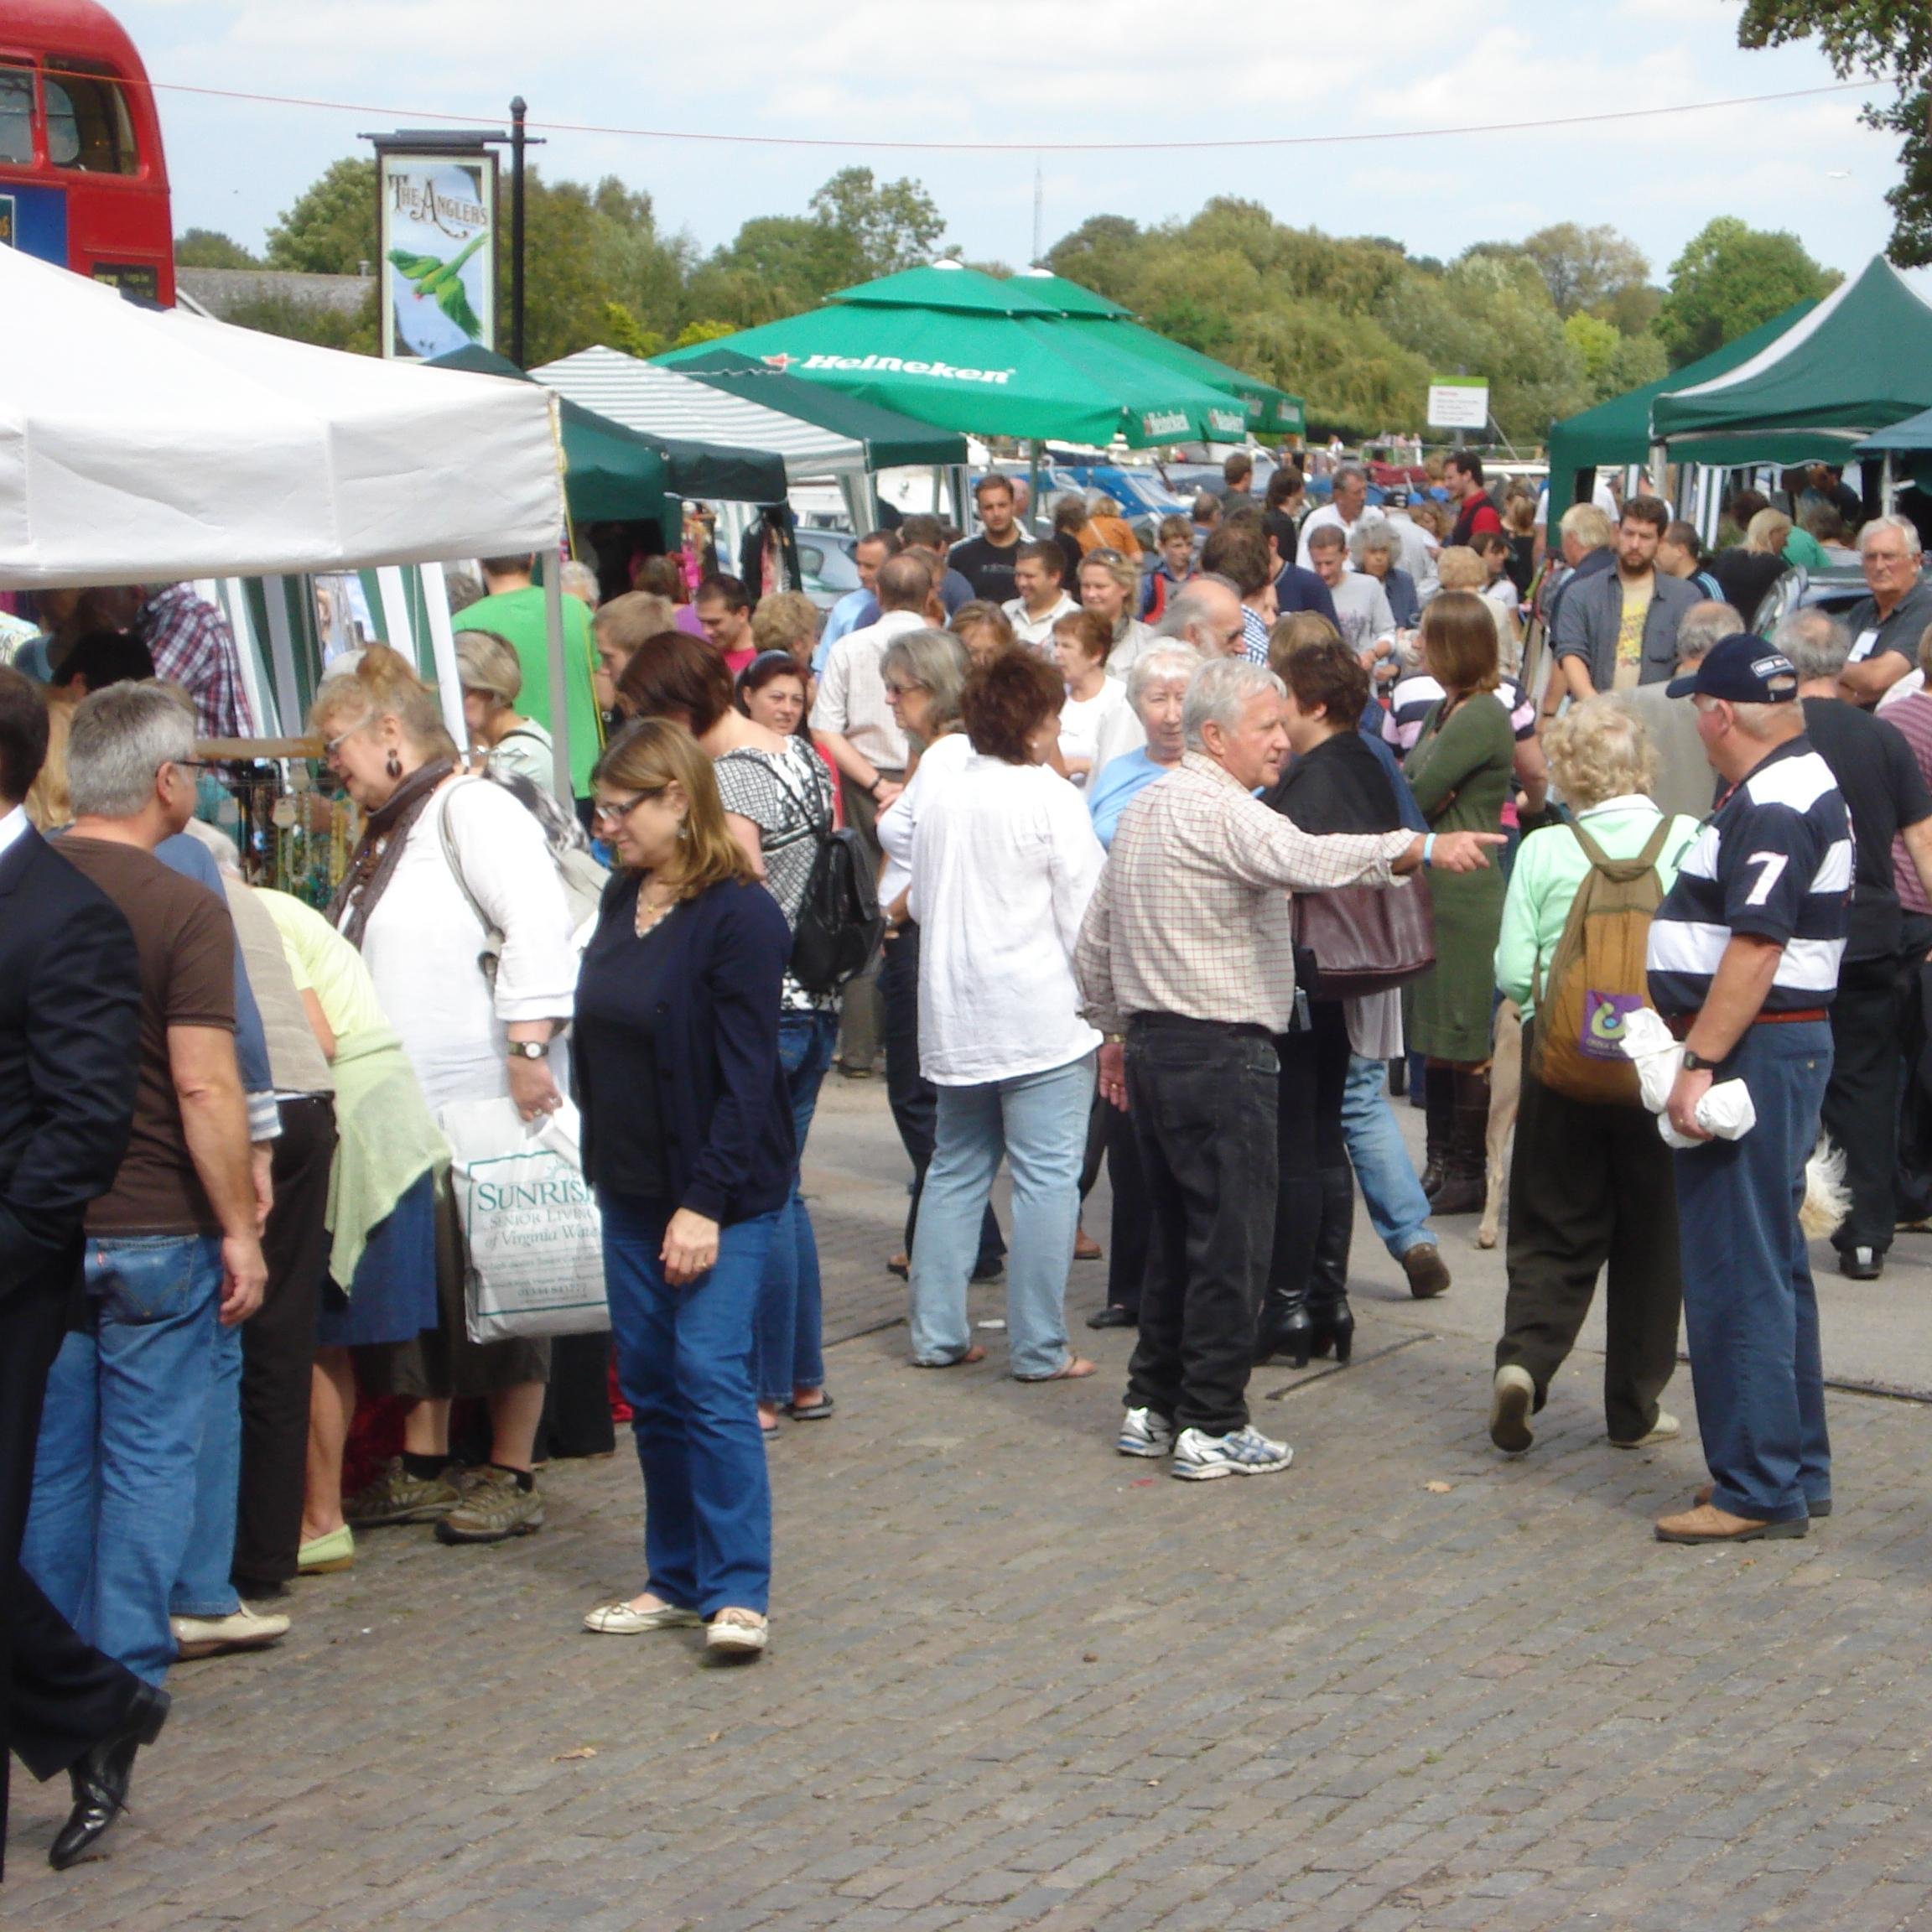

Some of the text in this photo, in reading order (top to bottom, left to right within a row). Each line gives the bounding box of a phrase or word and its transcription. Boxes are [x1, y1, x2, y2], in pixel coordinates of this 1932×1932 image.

[388, 174, 488, 238] THE ANGLERS
[801, 354, 1010, 383] Heineken
[1745, 850, 1789, 906] 7
